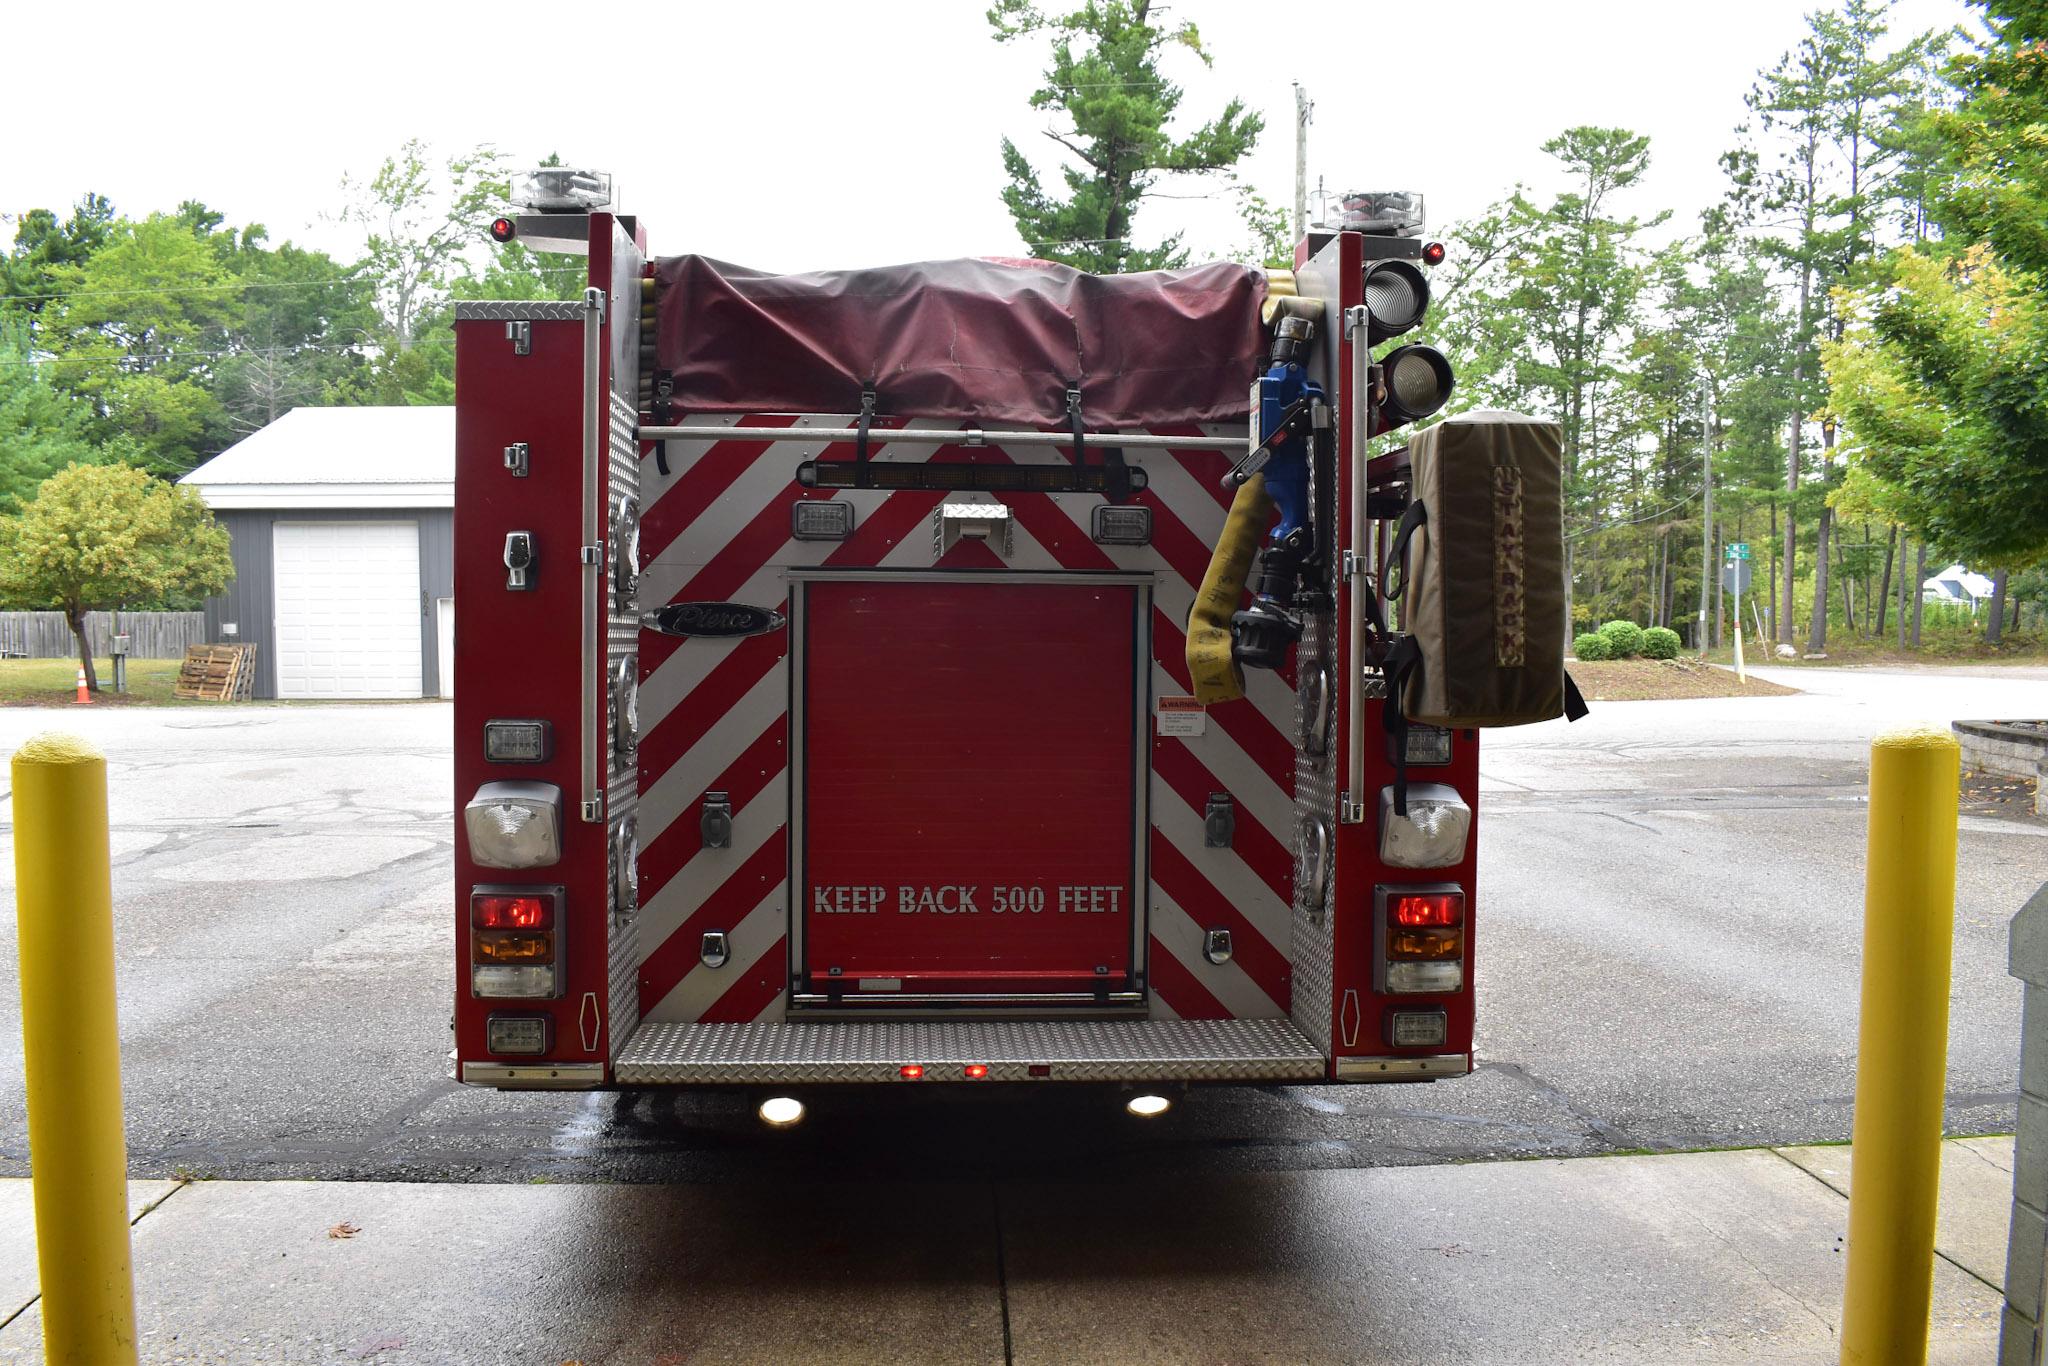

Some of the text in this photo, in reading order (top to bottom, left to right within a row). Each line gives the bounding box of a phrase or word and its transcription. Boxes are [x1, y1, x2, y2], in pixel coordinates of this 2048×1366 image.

[1501, 481, 1518, 649] STAY BACK
[672, 606, 752, 631] Pierce
[814, 886, 1124, 913] KEEP BACK 500 FEET
